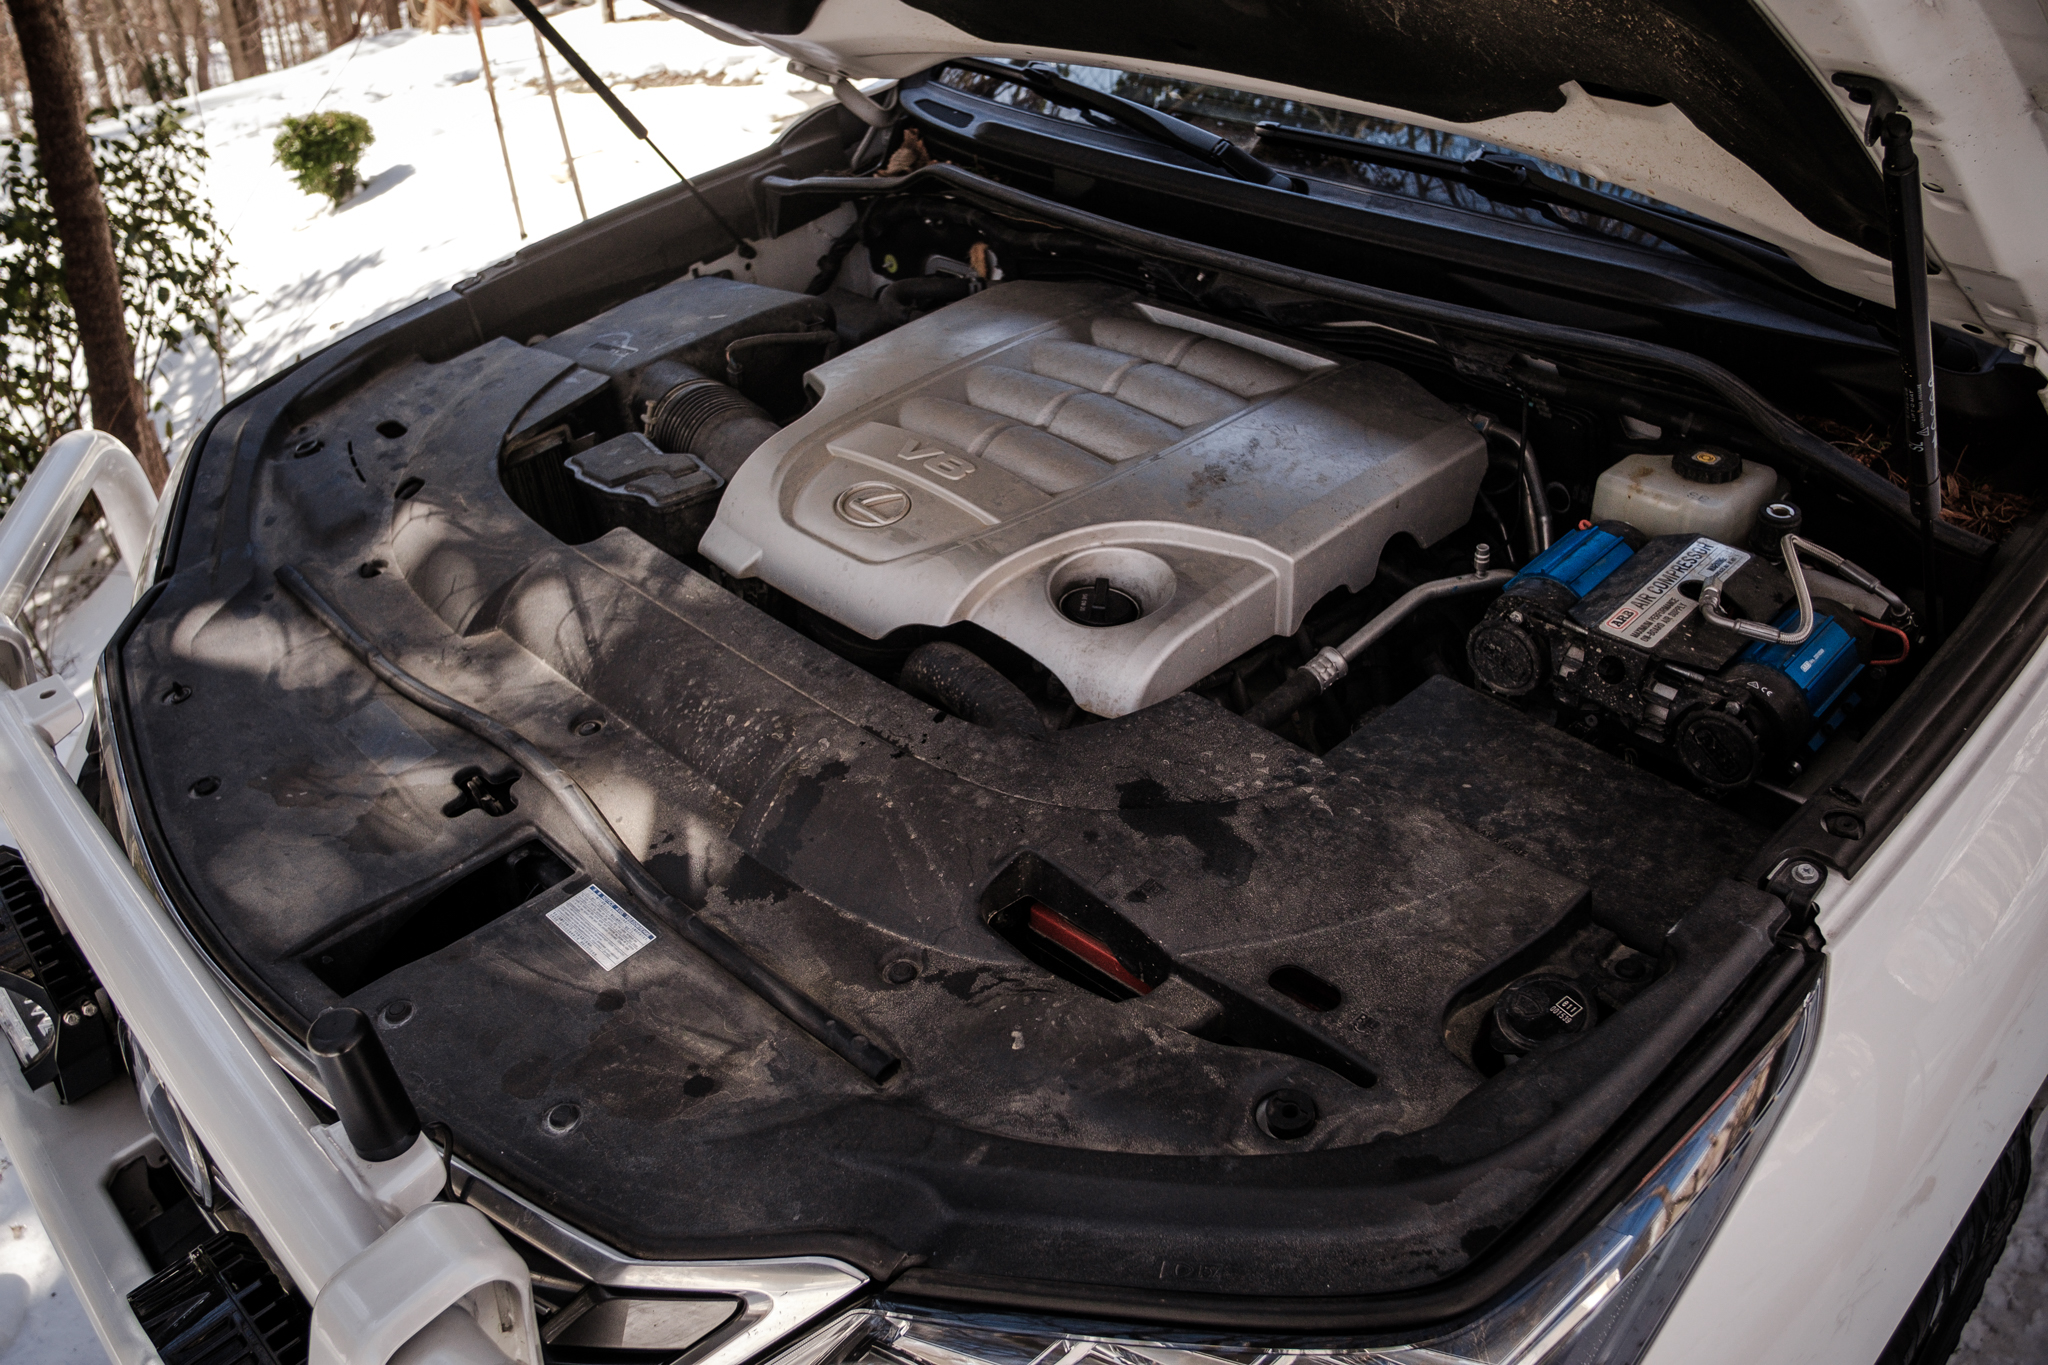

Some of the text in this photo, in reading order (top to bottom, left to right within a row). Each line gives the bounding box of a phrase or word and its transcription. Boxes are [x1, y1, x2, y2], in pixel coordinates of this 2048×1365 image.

[897, 438, 976, 480] V8
[1630, 591, 1657, 610] AIR
[1647, 541, 1714, 594] COMPRESSOR
[1611, 608, 1635, 627] ARB
[1630, 596, 1680, 638] MAXIMUM PERFORMANCE
[1640, 602, 1688, 642] ON-BOARD AIR SUPPLY
[1561, 1000, 1578, 1012] e11
